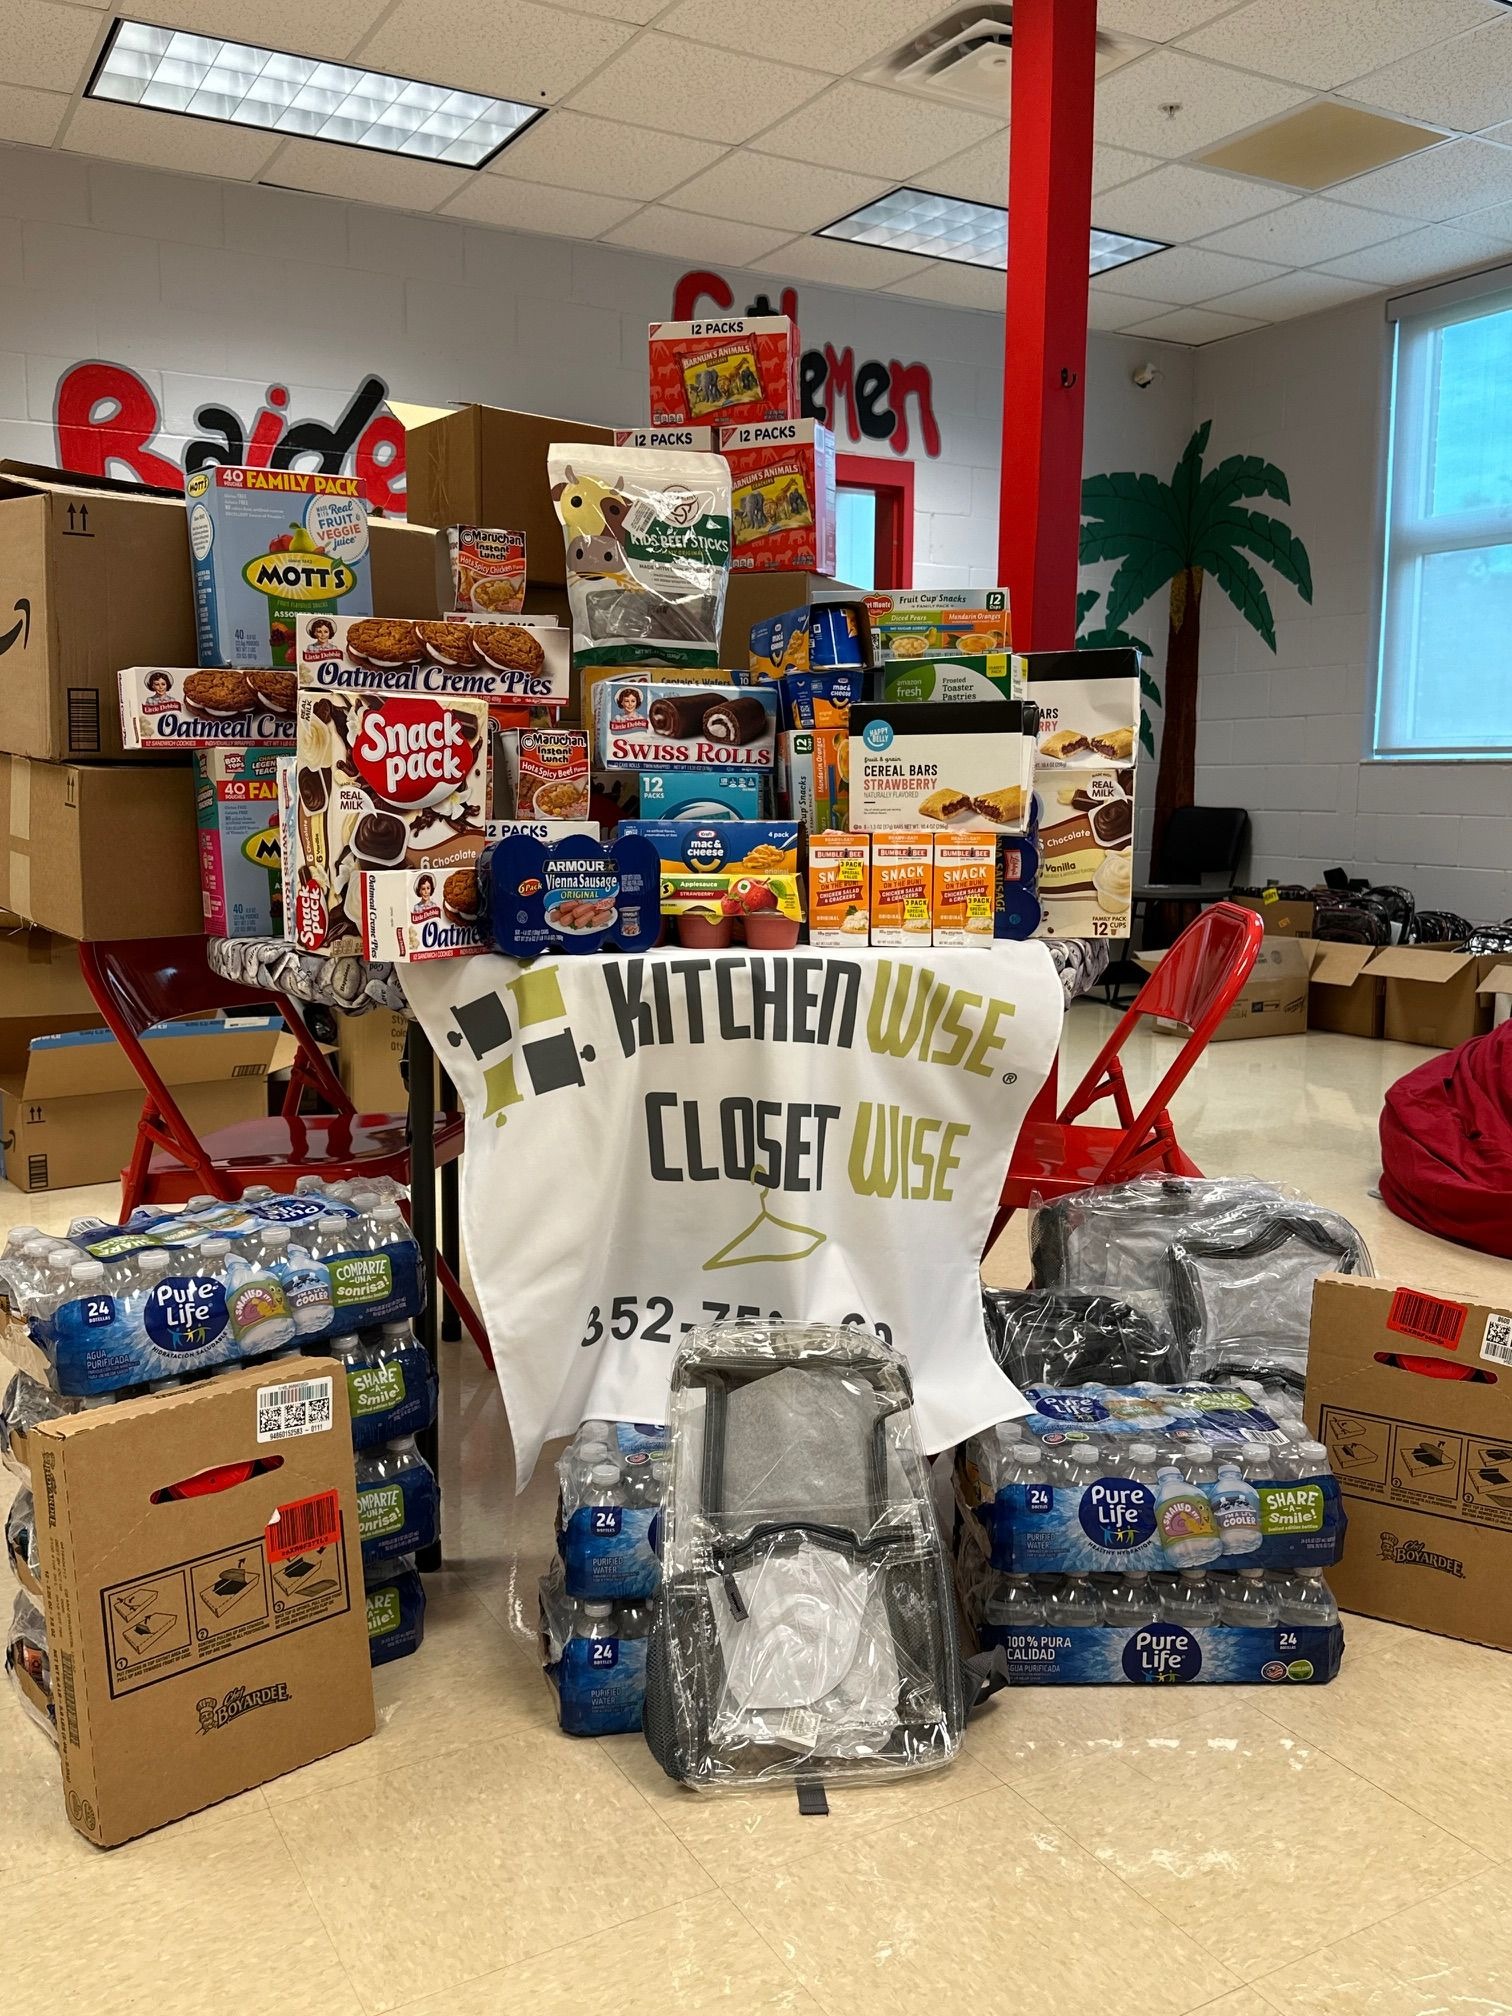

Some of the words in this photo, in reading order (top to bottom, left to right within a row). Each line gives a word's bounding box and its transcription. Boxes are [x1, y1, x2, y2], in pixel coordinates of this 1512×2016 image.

[691, 324, 702, 335] 12
[706, 322, 744, 334] PACKS
[683, 351, 718, 368] BARNUM'S
[718, 345, 750, 358] ANIMALS
[53, 359, 404, 515] Raide
[635, 435, 646, 446] 12
[650, 433, 693, 446] PACKS
[740, 430, 750, 442] 12
[754, 426, 796, 441] PACKS
[222, 469, 244, 482] 40
[247, 472, 312, 493] FAMILY
[314, 476, 359, 497] PACK
[317, 523, 361, 541] VEGGIE
[472, 530, 523, 546] Maruchan
[475, 543, 510, 553] Instant
[631, 533, 657, 548] KIDS
[661, 534, 689, 549] BEEF
[690, 536, 729, 552] STICKS
[480, 551, 506, 561] Lunch
[256, 565, 346, 589] MOTT'S
[899, 596, 918, 605] Fruit
[920, 594, 936, 604] Cup
[938, 594, 967, 603] Snacks
[989, 594, 1001, 606] 12
[949, 613, 976, 621] Mandarin
[977, 613, 1001, 621] Oranges
[303, 651, 319, 661] Little
[320, 650, 342, 660] Debbie
[317, 662, 417, 692] Oatmeal
[423, 667, 496, 694] Creme
[500, 670, 552, 696] Pies
[896, 686, 922, 696] fresh
[942, 693, 976, 701] Pastries
[157, 714, 251, 738] Oatmeal
[256, 715, 297, 738] Cre
[870, 727, 888, 736] HAPPY
[361, 711, 464, 762] Snack
[535, 734, 587, 748] Maruchan
[872, 735, 889, 743] BELLY
[537, 745, 573, 756] Instant
[612, 739, 689, 761] SWISS
[696, 742, 770, 765] ROLLS
[224, 756, 241, 765] BOX
[541, 755, 570, 763] Lunch
[386, 748, 464, 793] pack
[864, 765, 905, 777] CEREAL
[909, 764, 938, 776] BARS
[224, 783, 245, 795] 40
[643, 777, 663, 792] 12
[864, 778, 938, 791] STRAWBERRY
[1092, 780, 1114, 789] REAL
[340, 790, 363, 801] REAL
[864, 791, 893, 799] NATURALLY
[1092, 789, 1115, 798] MILK
[340, 800, 364, 811] MILK
[501, 825, 548, 838] PACKS
[1046, 828, 1091, 847] Chocolate
[306, 854, 313, 862] 6
[433, 849, 477, 869] Chocolate
[547, 861, 605, 872] ARMOUR
[881, 865, 924, 881] SNACK
[1045, 861, 1077, 873] Vanilla
[943, 867, 987, 882] SNACK
[518, 883, 524, 894] 6
[525, 882, 543, 892] Pack
[545, 874, 578, 890] Vienna
[579, 874, 617, 892] Sausage
[996, 863, 1006, 913] SAUSAGE
[560, 891, 599, 899] ORIGINAL
[300, 885, 315, 946] Snack
[310, 888, 324, 934] pack
[1092, 922, 1108, 936] 12
[602, 956, 863, 1059] KITCHEN
[865, 961, 1017, 1079] WISE
[644, 1091, 842, 1193] CLOSET
[848, 1101, 972, 1202] WISE
[336, 1260, 387, 1280] COMPARTE
[157, 1282, 214, 1307] Pure
[336, 1278, 390, 1297] sonrisa!
[295, 1292, 329, 1308] COOLER
[87, 1301, 110, 1317] 24
[167, 1302, 210, 1328] Life
[88, 1316, 111, 1324] BOTELLAS
[152, 1346, 195, 1360] HIDRATACIÓN
[196, 1330, 228, 1356] SALUDABLE
[86, 1350, 107, 1361] AGUA
[87, 1354, 130, 1370] PURIFICADA
[353, 1367, 397, 1392] SHARE
[358, 1385, 400, 1406] Smile!
[1043, 1397, 1094, 1408] Pure
[1053, 1404, 1093, 1415] Life
[1031, 1490, 1048, 1504] 24
[1091, 1485, 1144, 1504] Pure
[1266, 1491, 1319, 1510] SHARE
[596, 1513, 616, 1528] 24
[1099, 1505, 1138, 1527] Life
[1164, 1502, 1192, 1526] SNAILED
[1268, 1509, 1318, 1525] Smile!
[1223, 1517, 1257, 1528] COOLER
[1026, 1533, 1055, 1541] PURIFIED
[1403, 1540, 1425, 1552] Chef
[593, 1558, 623, 1567] PURIFIED
[1395, 1548, 1464, 1579] BOYARDEE
[593, 1566, 618, 1575] WATER
[1041, 1636, 1072, 1648] PURA
[1136, 1632, 1188, 1651] Pure
[1279, 1633, 1297, 1645] 24
[594, 1645, 613, 1659] 24
[1007, 1649, 1056, 1661] CALIDAD
[1141, 1650, 1182, 1672] Life
[223, 1685, 246, 1706] Chef
[591, 1688, 622, 1698] PURIFIED
[216, 1683, 289, 1729] BOYARDEE
[591, 1697, 616, 1706] WATER
